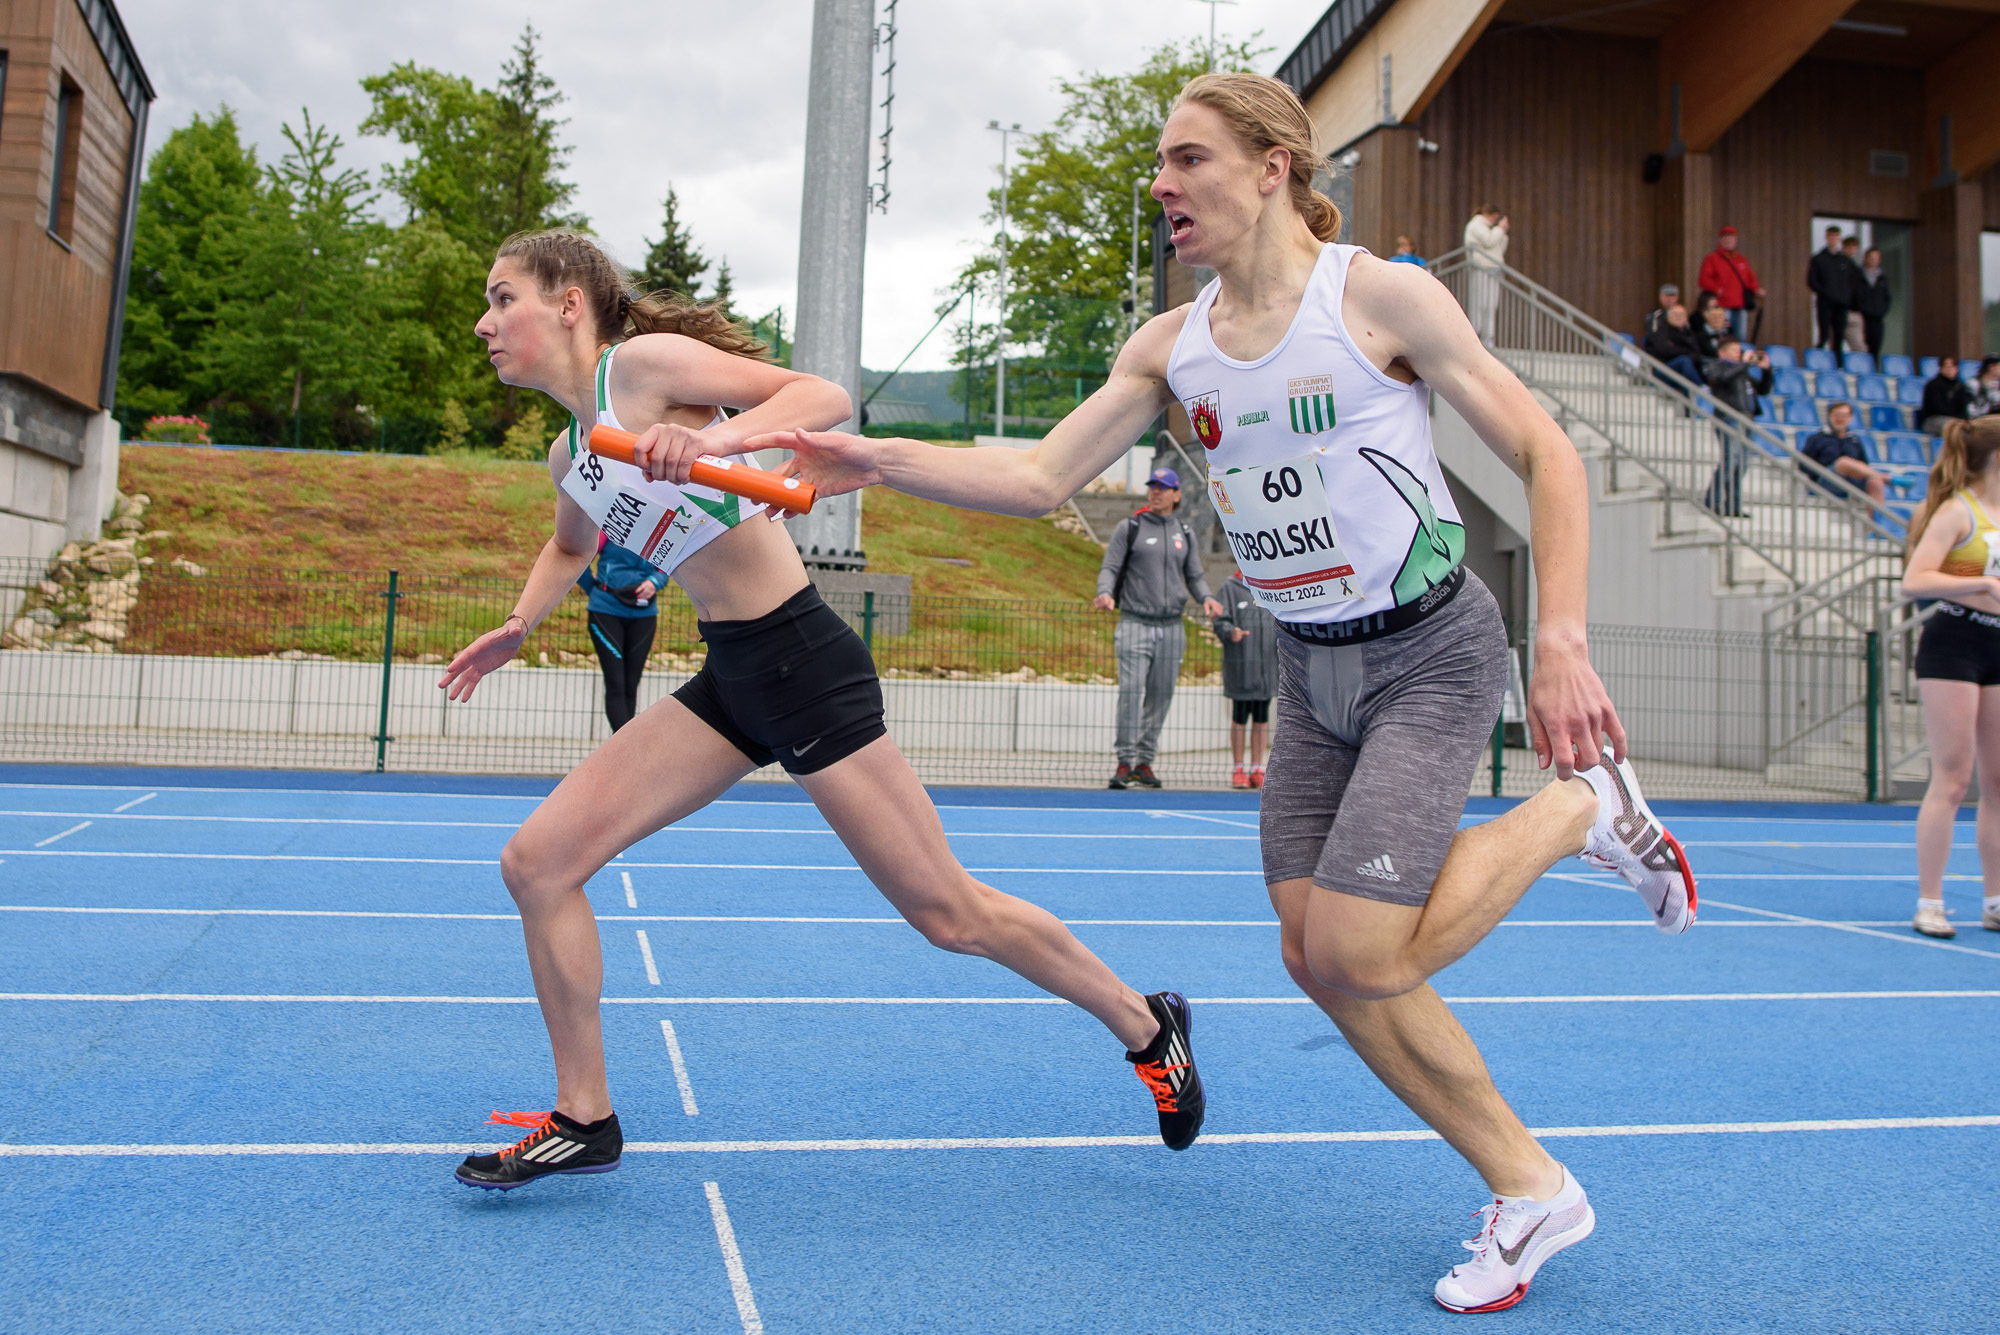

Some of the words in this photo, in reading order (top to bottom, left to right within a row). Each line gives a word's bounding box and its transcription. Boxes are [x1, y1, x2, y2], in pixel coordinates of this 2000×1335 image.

[578, 453, 604, 491] 58
[1262, 466, 1302, 503] 60
[1227, 516, 1335, 561] TOBOLSKI
[1296, 585, 1326, 600] 2022
[1419, 585, 1451, 612] adidas
[1356, 866, 1400, 882] adidas
